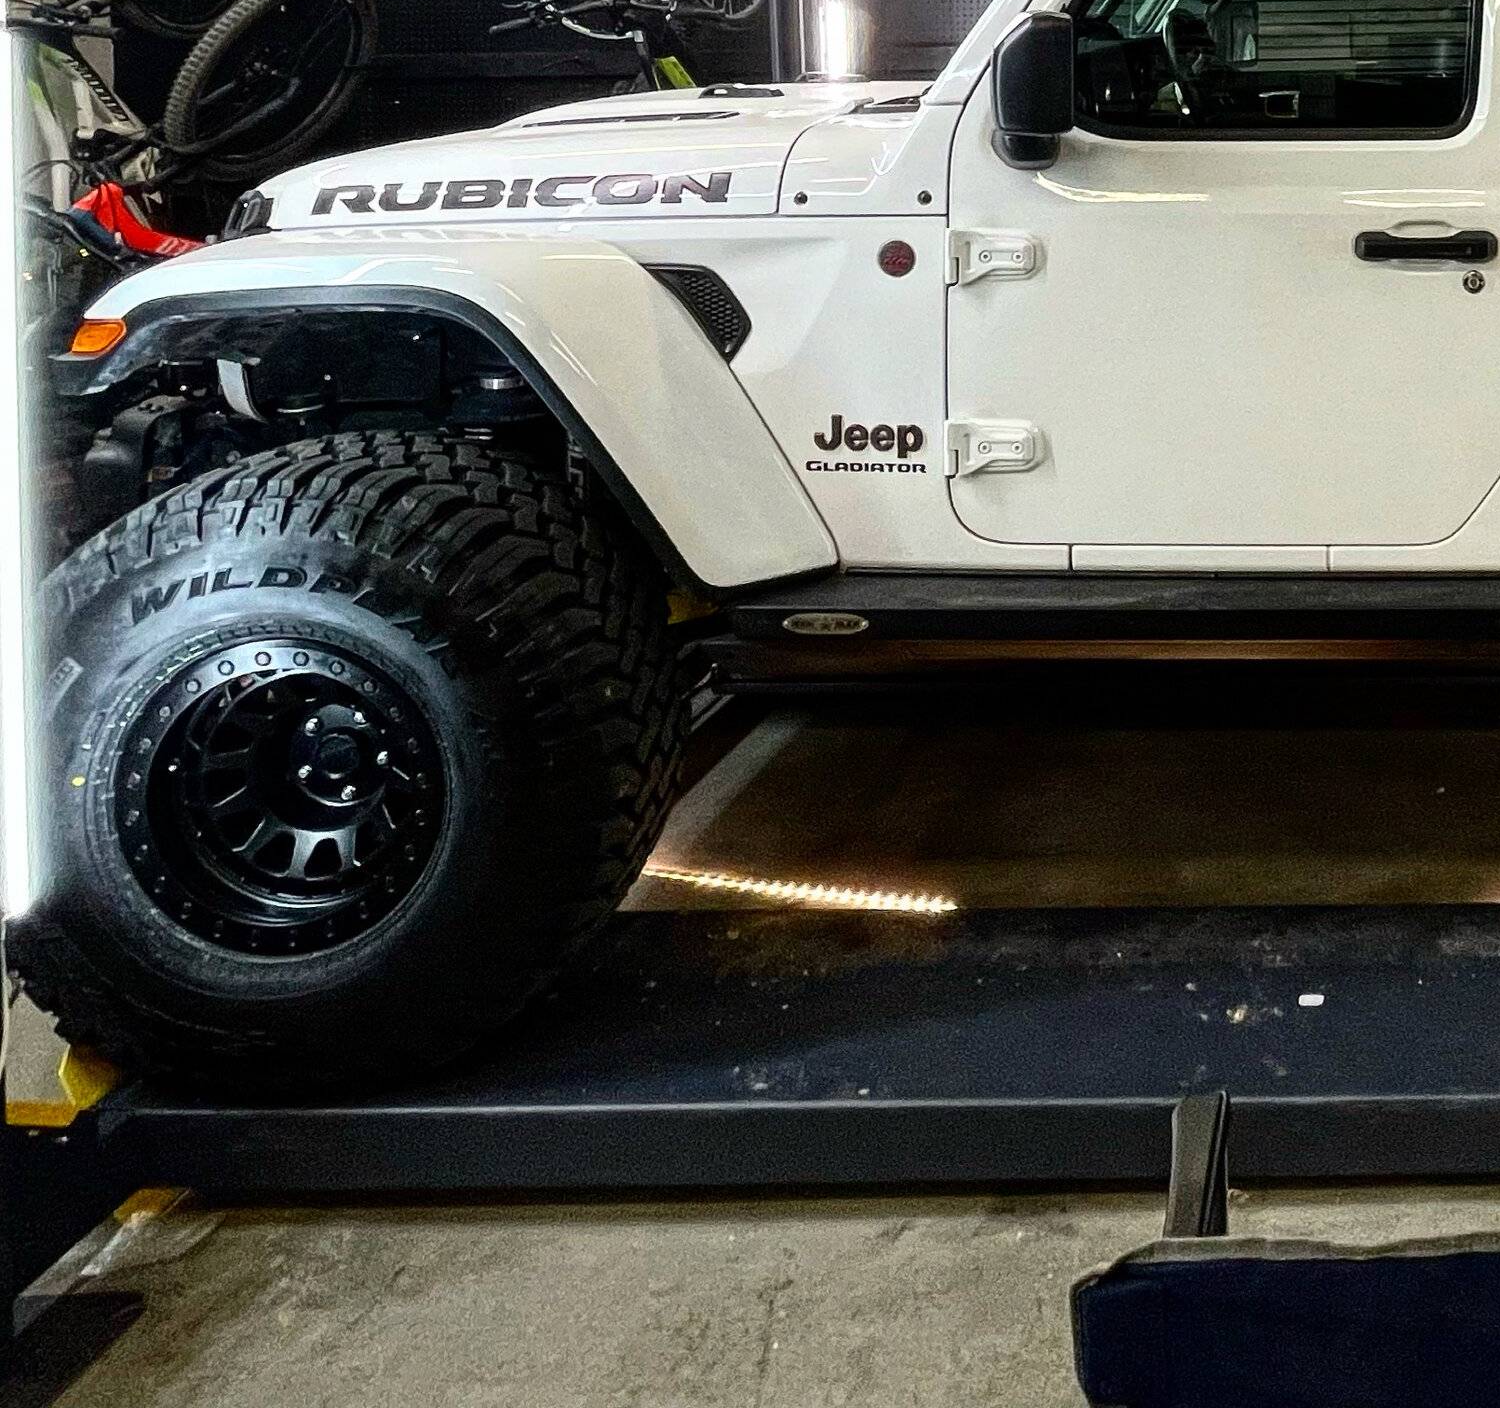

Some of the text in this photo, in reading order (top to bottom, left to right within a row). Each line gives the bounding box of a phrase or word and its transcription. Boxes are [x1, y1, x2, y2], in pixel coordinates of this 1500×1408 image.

[311, 172, 733, 215] RUBICON
[813, 413, 924, 459] Jeep
[805, 460, 928, 474] GLADIATOR
